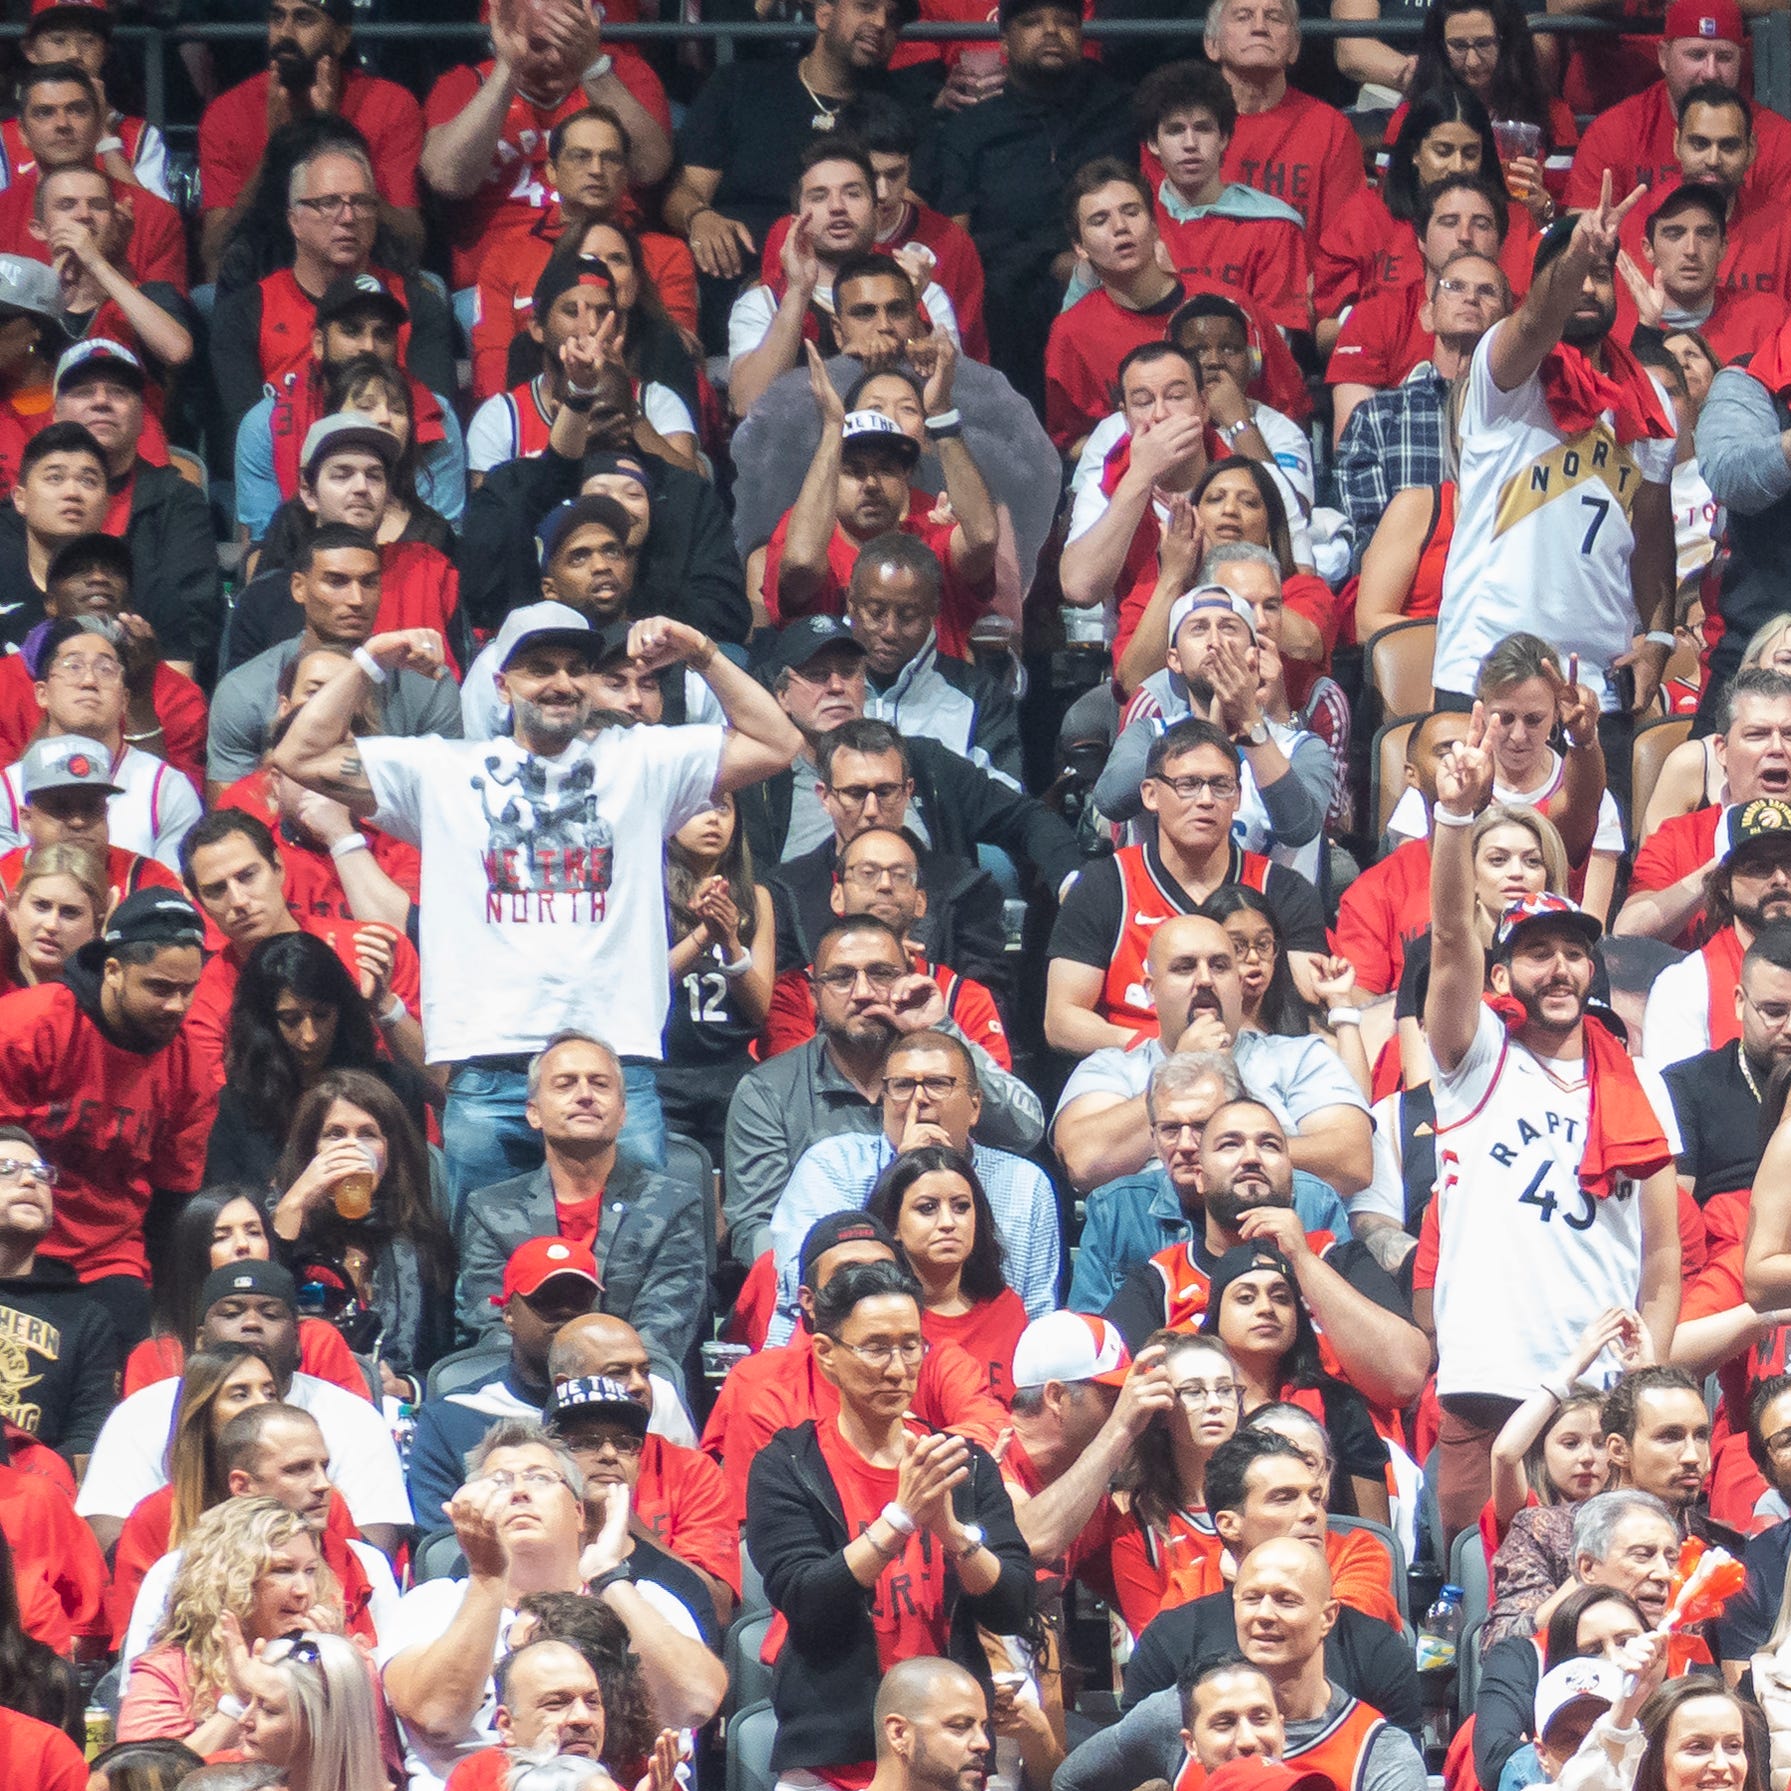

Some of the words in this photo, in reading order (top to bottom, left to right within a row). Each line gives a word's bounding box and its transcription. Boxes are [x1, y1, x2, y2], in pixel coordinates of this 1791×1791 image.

[1241, 159, 1310, 198] THE
[1530, 448, 1631, 494] NORT
[1581, 494, 1610, 555] 7
[486, 889, 608, 925] NORTH
[682, 972, 728, 1022] 12
